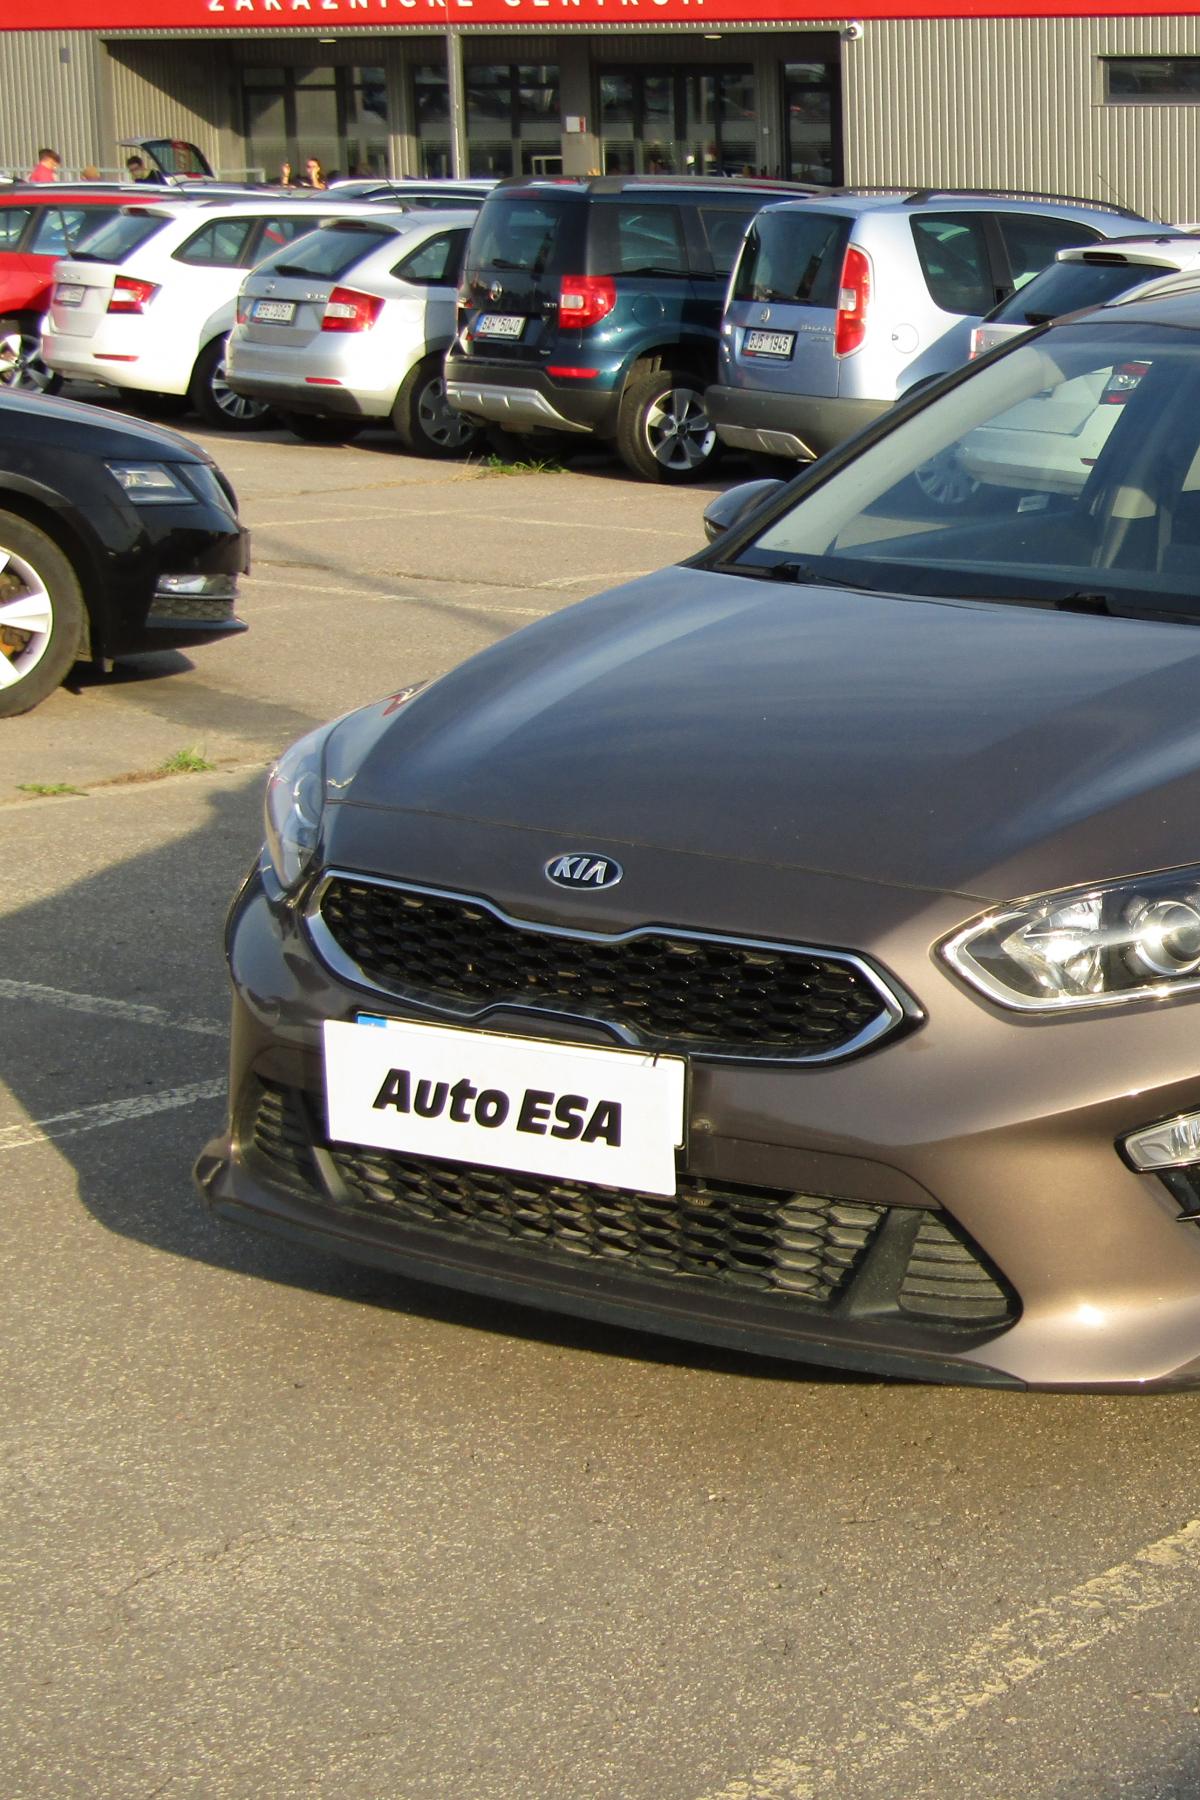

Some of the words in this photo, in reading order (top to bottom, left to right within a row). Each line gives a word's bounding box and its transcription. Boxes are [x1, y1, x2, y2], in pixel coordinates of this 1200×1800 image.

[553, 856, 608, 884] KIA
[372, 1067, 511, 1129] Auto
[515, 1088, 623, 1148] ESA
